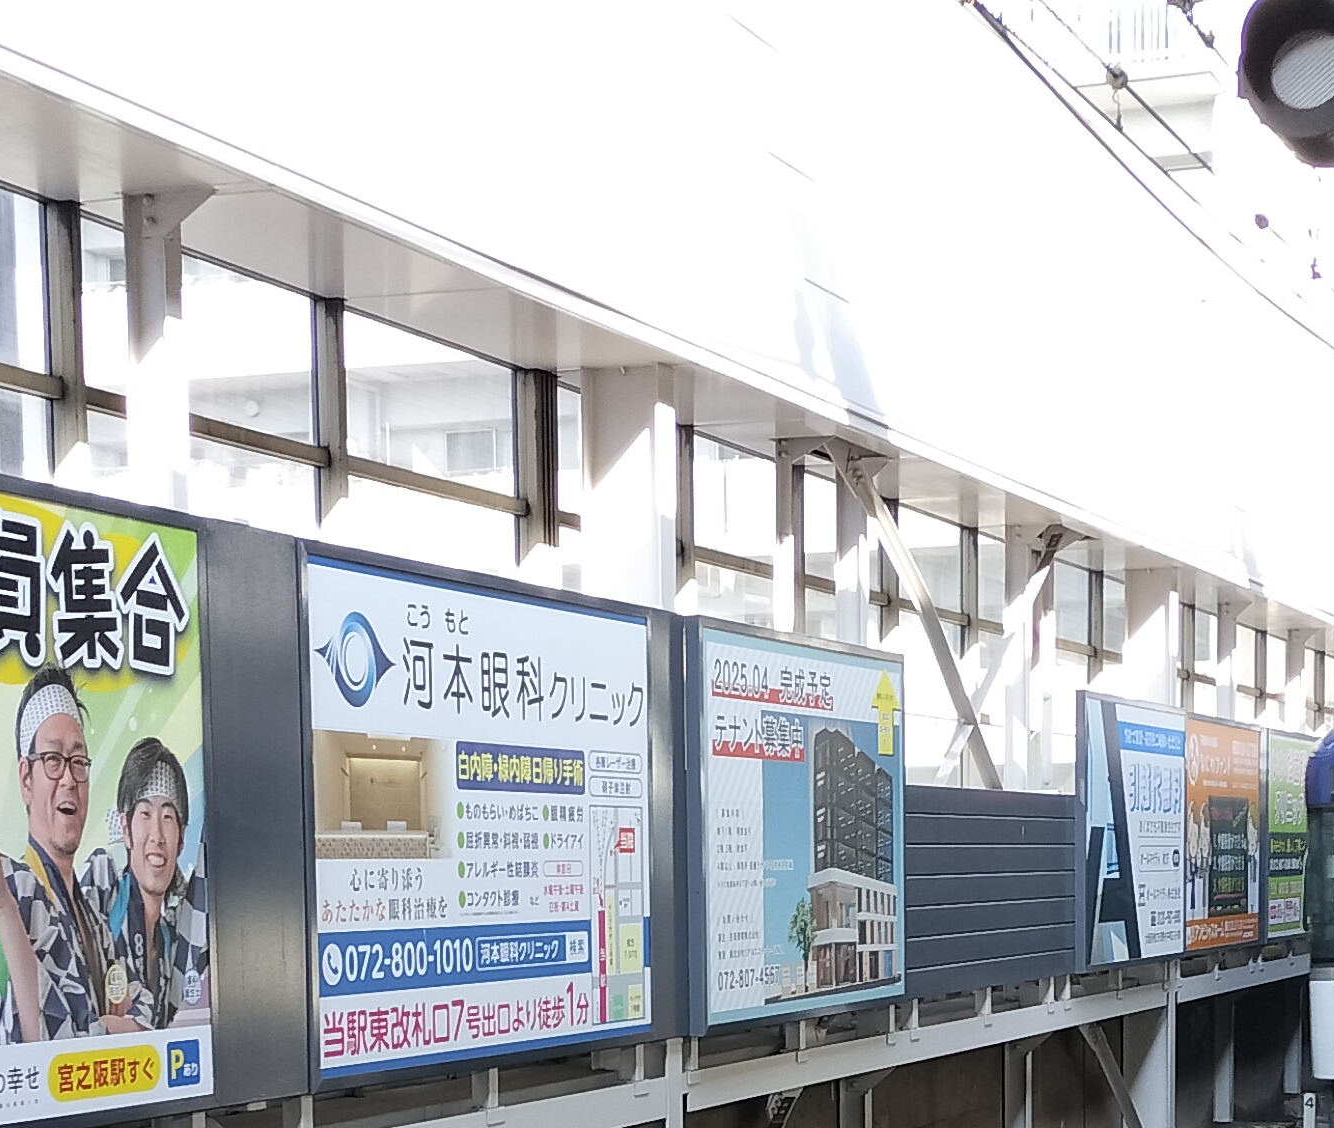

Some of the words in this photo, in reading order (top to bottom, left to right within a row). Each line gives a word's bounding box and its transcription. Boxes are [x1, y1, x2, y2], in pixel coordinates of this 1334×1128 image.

[407, 604, 431, 629] こう
[445, 608, 469, 635] もと
[402, 636, 644, 728] 河本眼科クリニック
[713, 657, 769, 694] 2025.04
[779, 665, 833, 711] 完成予定
[713, 713, 805, 761] テナント募集中
[457, 750, 584, 788] 白内障・緑内障日帰り手術
[465, 803, 539, 822] ものもらい・めばちこ
[550, 832, 584, 850] ドライアイ
[349, 867, 424, 892] 心に寄り添う
[321, 895, 449, 924] あたたかな眼科治療を
[344, 937, 474, 982] 072-800-1010
[479, 939, 560, 966] 河本眼科クリニック
[322, 981, 590, 1059] 当駅東改札口7号出口より徒歩1分
[57, 1056, 157, 1094] 宮之阪駅すぐ
[1304, 1097, 1314, 1109] 4
